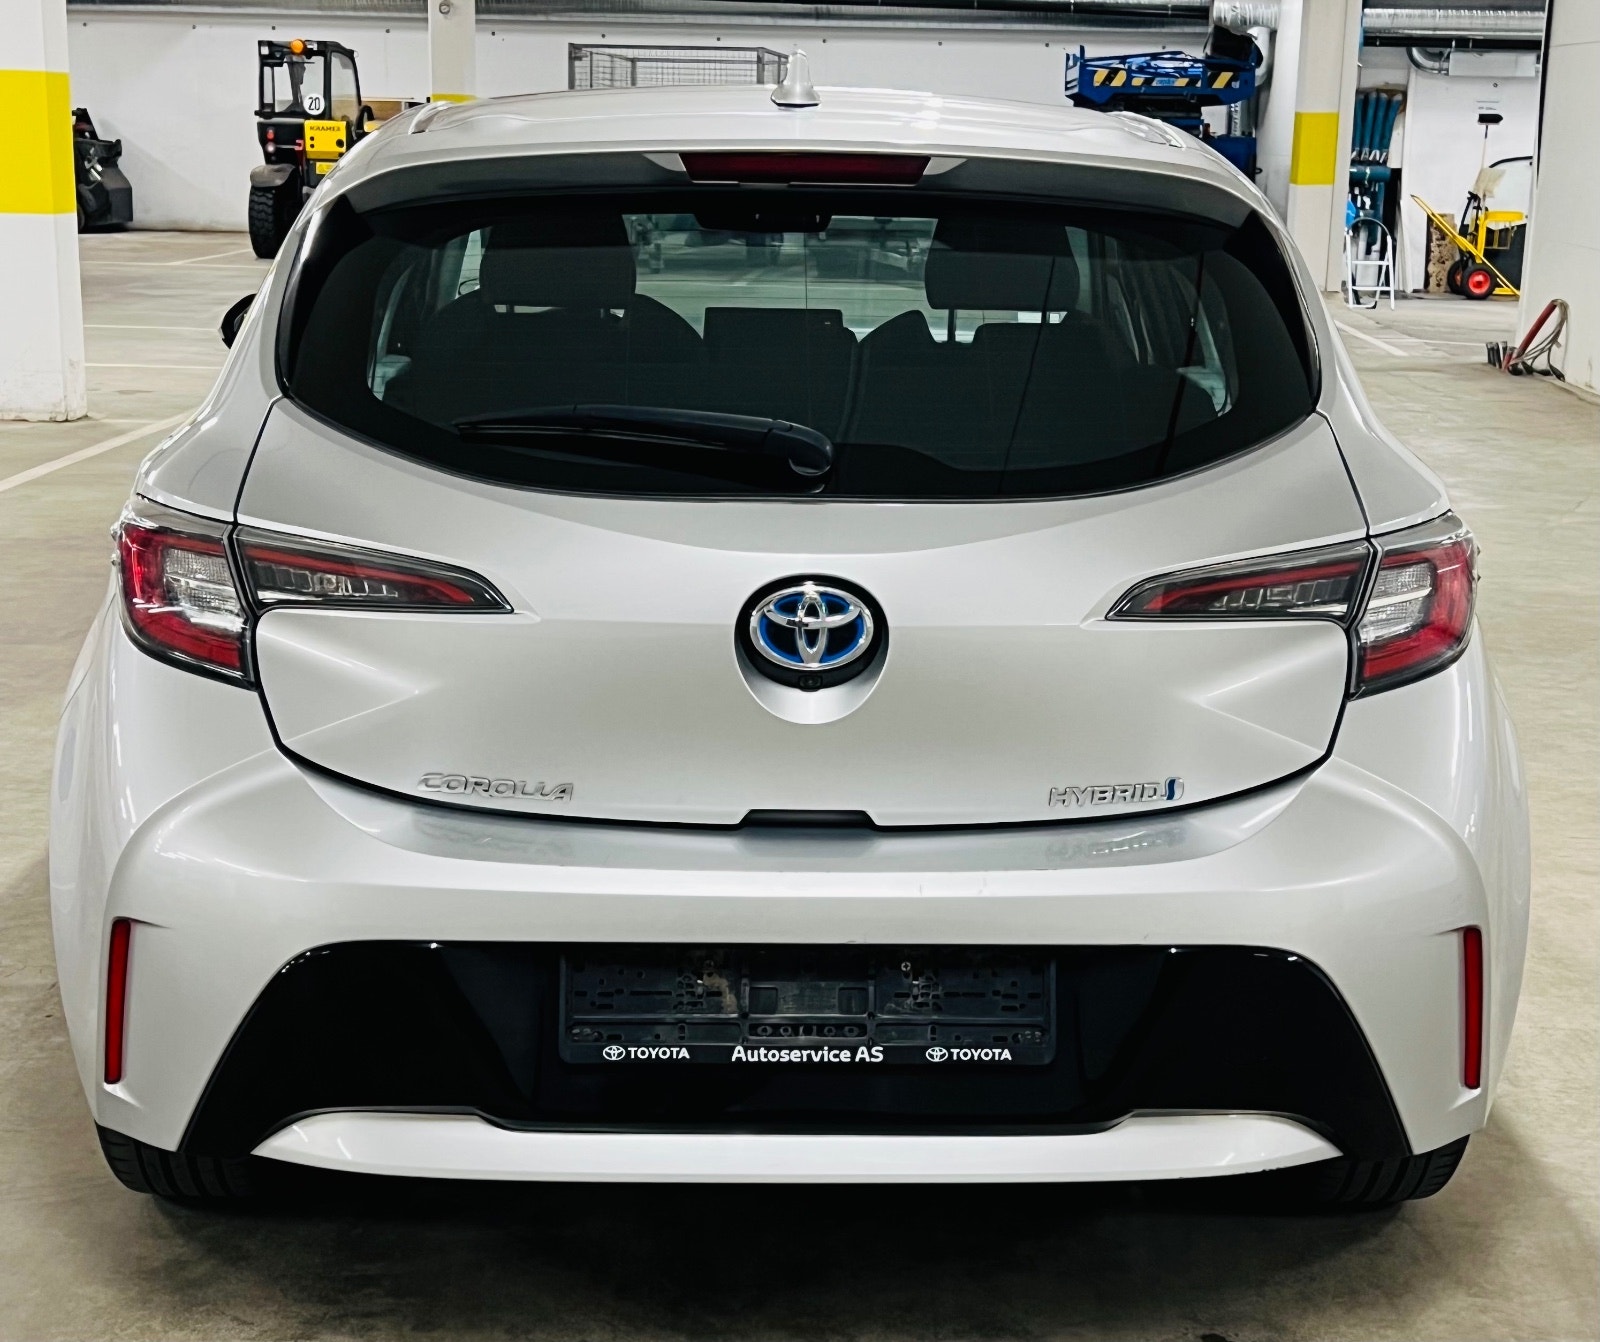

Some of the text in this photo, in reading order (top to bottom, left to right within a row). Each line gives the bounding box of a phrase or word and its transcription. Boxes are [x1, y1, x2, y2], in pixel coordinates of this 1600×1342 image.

[307, 96, 321, 111] 20
[417, 772, 574, 802] COROLLA
[1049, 782, 1163, 808] HYBRID
[627, 1045, 1012, 1063] TOYOTA Autoservice AS TOYOTA
